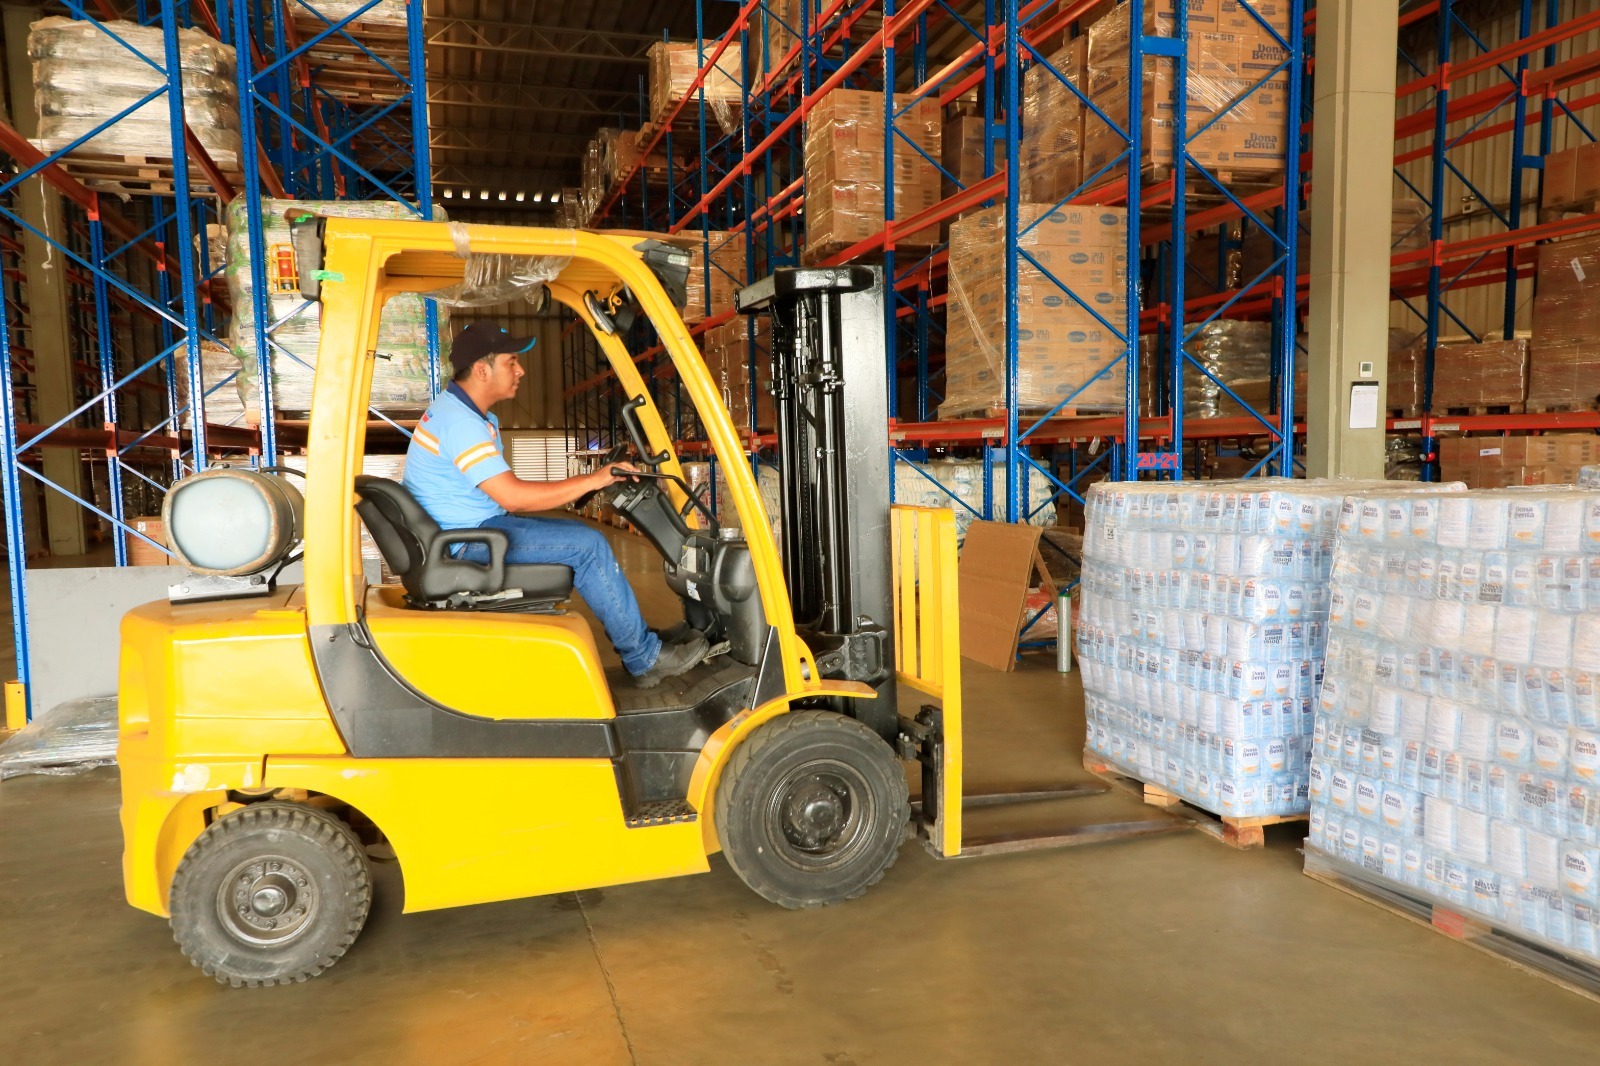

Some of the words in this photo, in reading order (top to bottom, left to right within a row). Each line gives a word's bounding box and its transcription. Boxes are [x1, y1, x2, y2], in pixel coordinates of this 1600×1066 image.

[1258, 44, 1286, 54] Dona
[1252, 50, 1284, 61] Benta
[1250, 132, 1278, 142] Dona
[1244, 139, 1276, 149] Benta
[1136, 452, 1178, 468] 20-21
[1501, 725, 1518, 734] Dona
[1576, 739, 1595, 748] Dona
[1575, 746, 1597, 755] Benta
[1334, 776, 1346, 784] Dona
[1359, 784, 1373, 793] Dona
[1386, 794, 1400, 804] Dona
[1566, 854, 1584, 865] Dona
[1565, 860, 1586, 872] Benta
